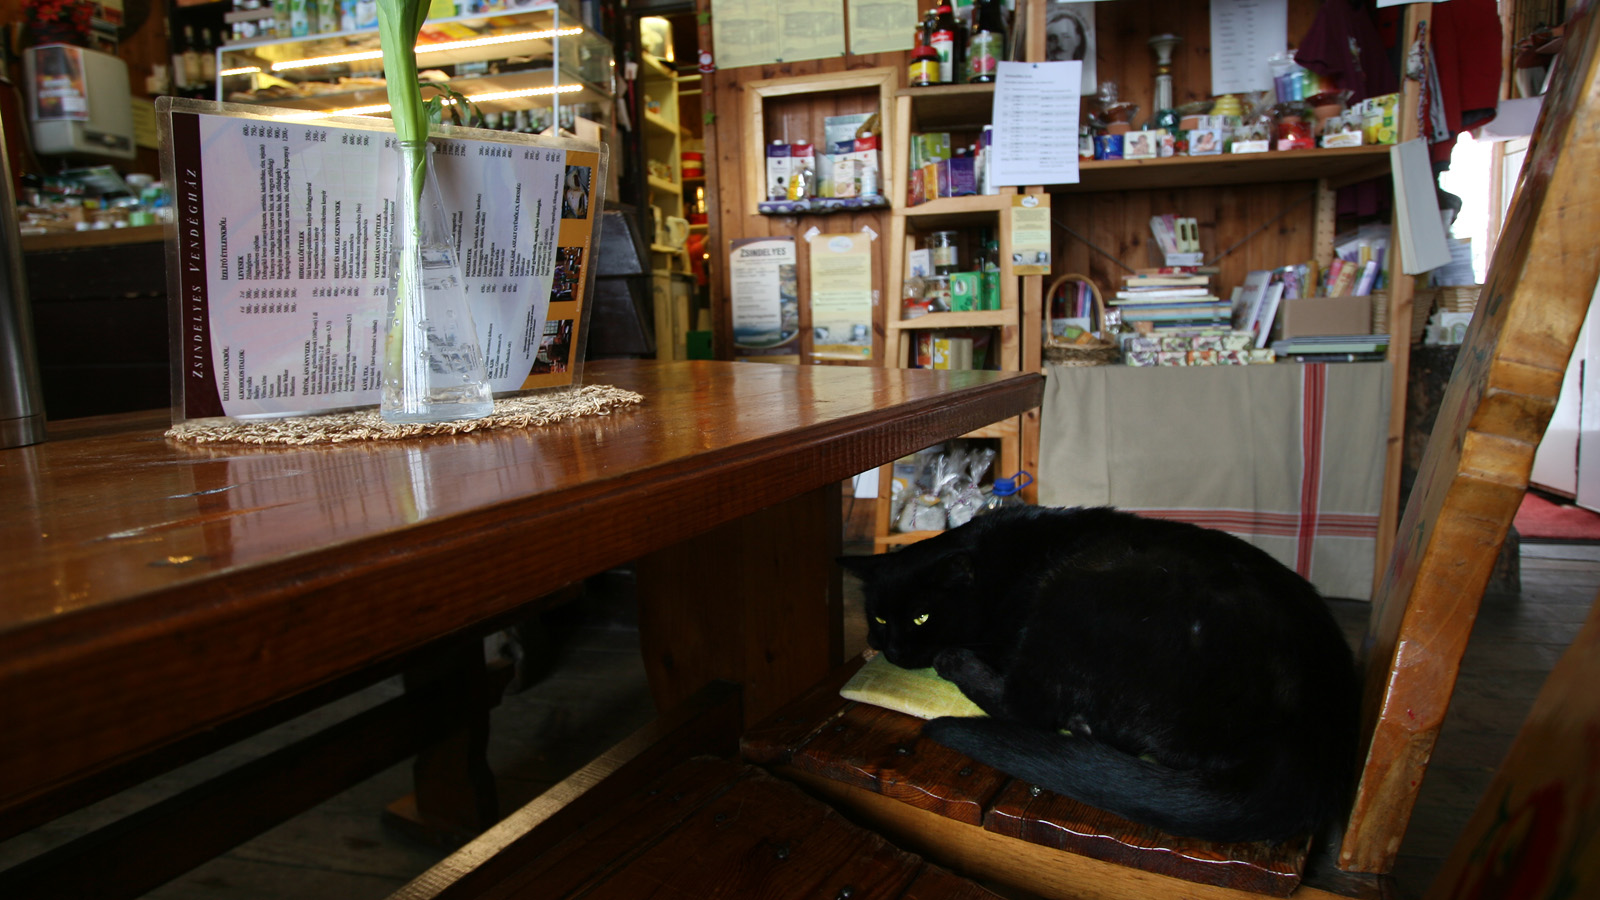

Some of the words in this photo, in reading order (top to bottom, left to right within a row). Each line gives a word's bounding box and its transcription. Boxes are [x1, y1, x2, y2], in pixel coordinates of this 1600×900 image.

[185, 169, 200, 272] VENDÉGHÁZ
[740, 247, 786, 258] ZSINDELYES
[192, 285, 203, 378] ZSINDELYES
